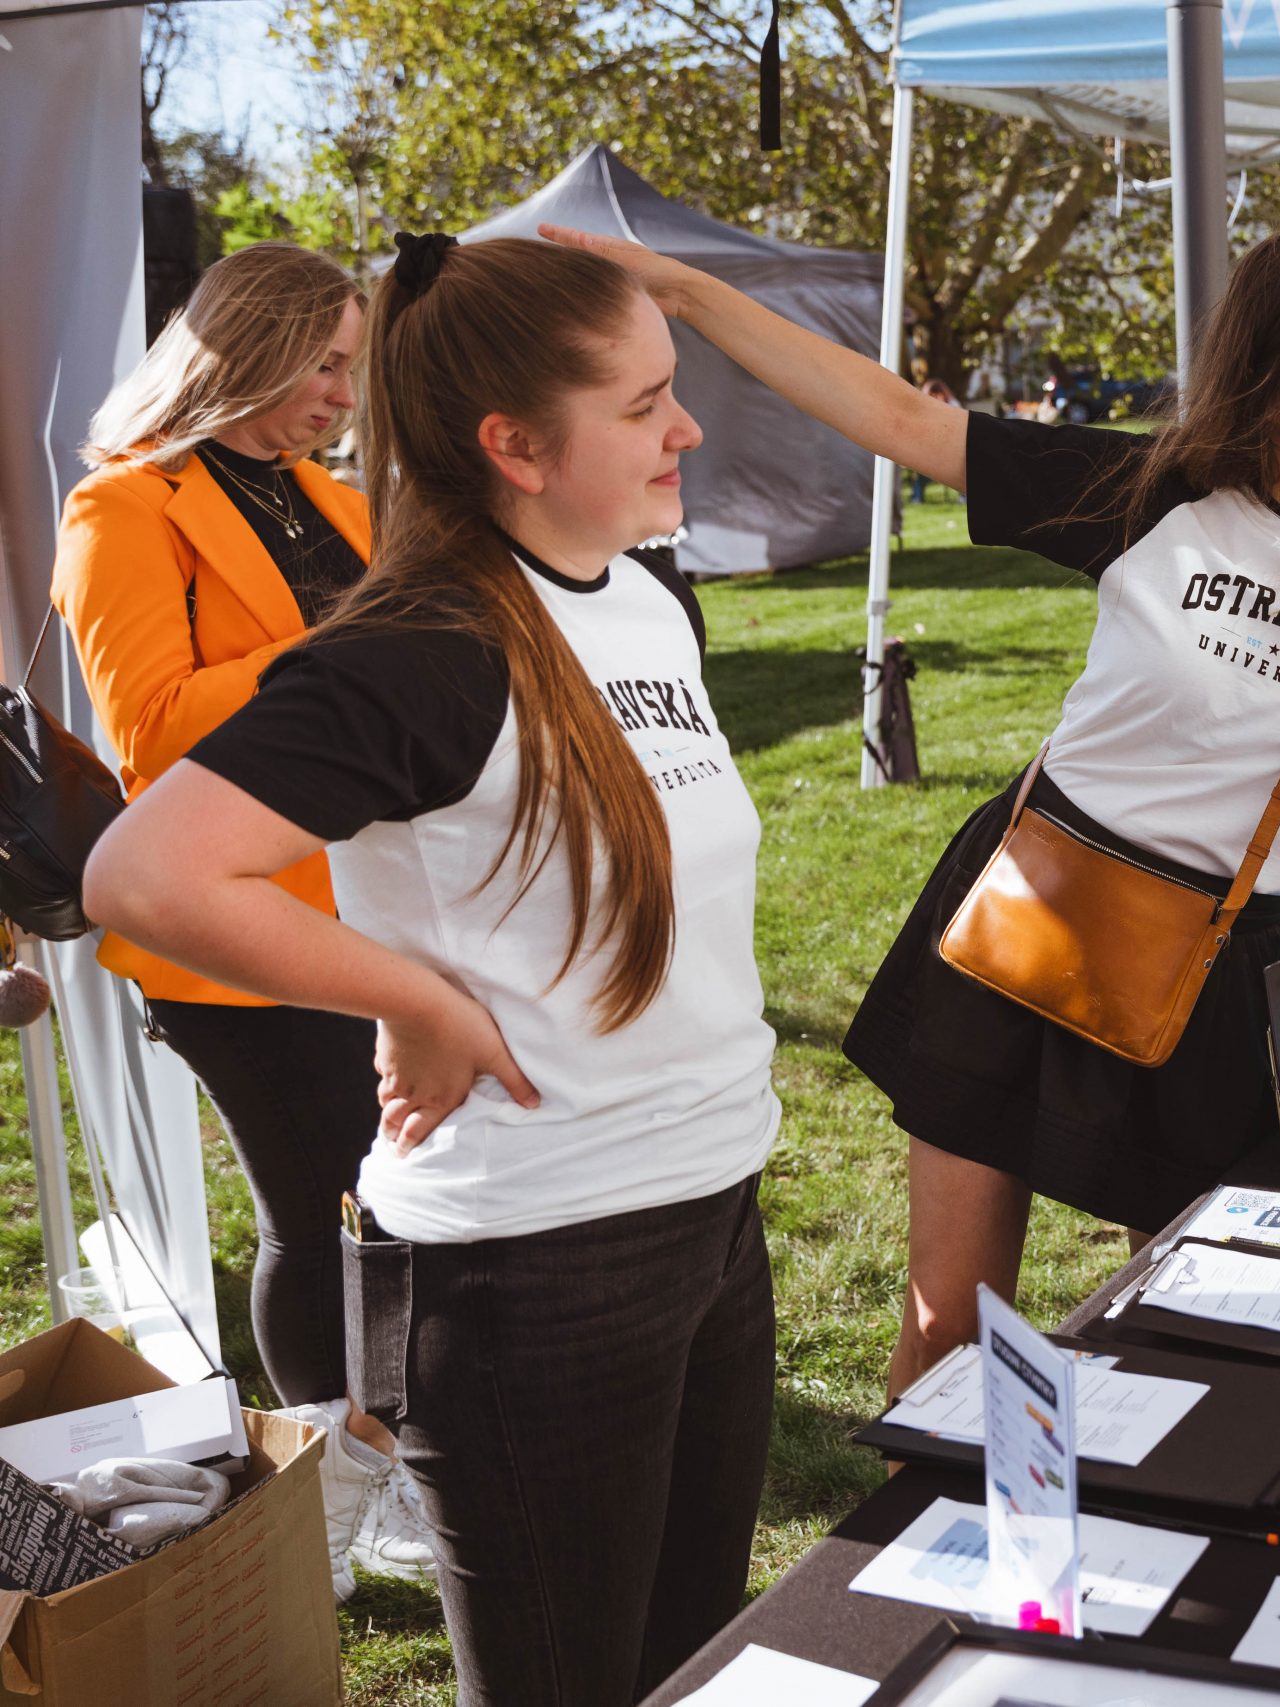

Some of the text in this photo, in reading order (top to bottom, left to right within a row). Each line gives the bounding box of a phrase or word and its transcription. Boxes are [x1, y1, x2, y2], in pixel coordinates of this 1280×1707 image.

[11, 1499, 57, 1585] shopping
[61, 1542, 84, 1589] conceptual
[30, 1550, 55, 1594] clothing
